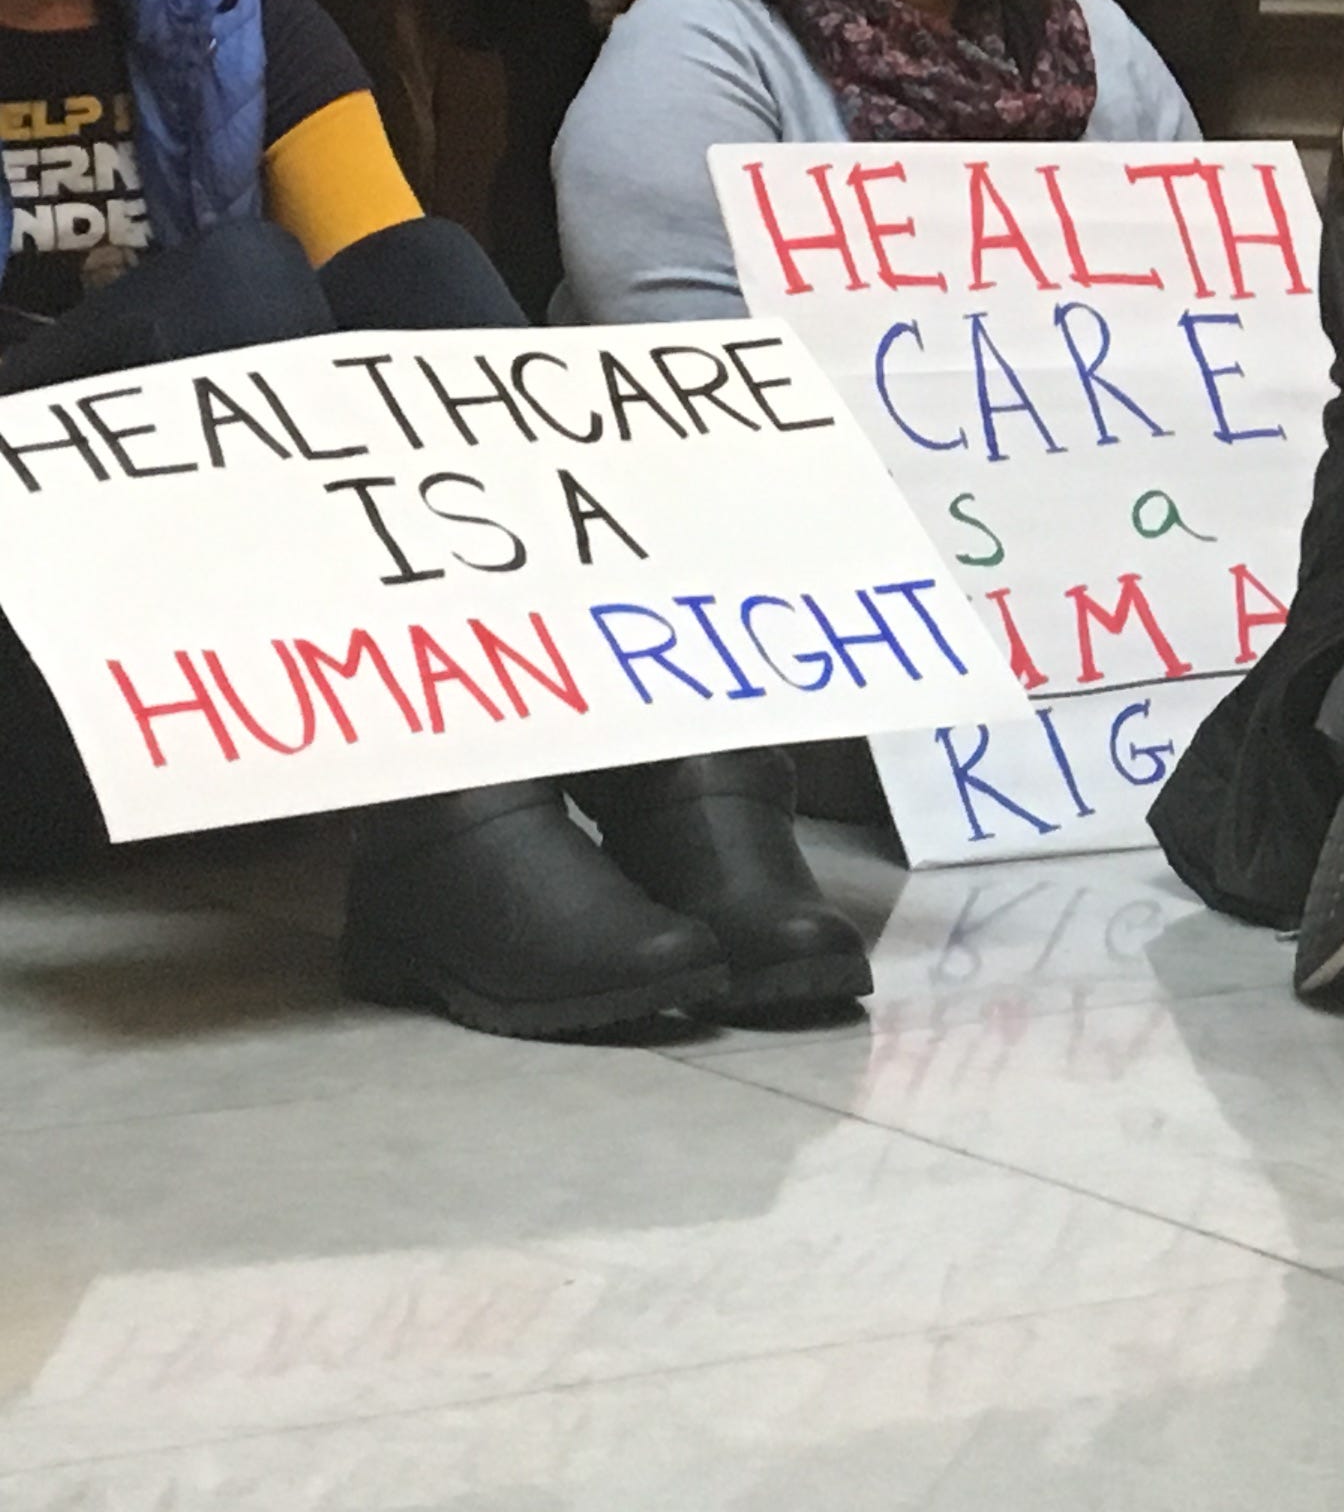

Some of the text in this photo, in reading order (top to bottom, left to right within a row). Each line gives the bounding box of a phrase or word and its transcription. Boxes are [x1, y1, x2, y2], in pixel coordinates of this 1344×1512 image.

[742, 158, 1312, 300] HEALTH
[0, 337, 835, 494] HEALTHCARE
[875, 301, 1287, 461] CARE
[325, 468, 648, 585] IS A
[1132, 489, 1218, 542] a
[106, 578, 969, 766] HUMAN RIGHT
